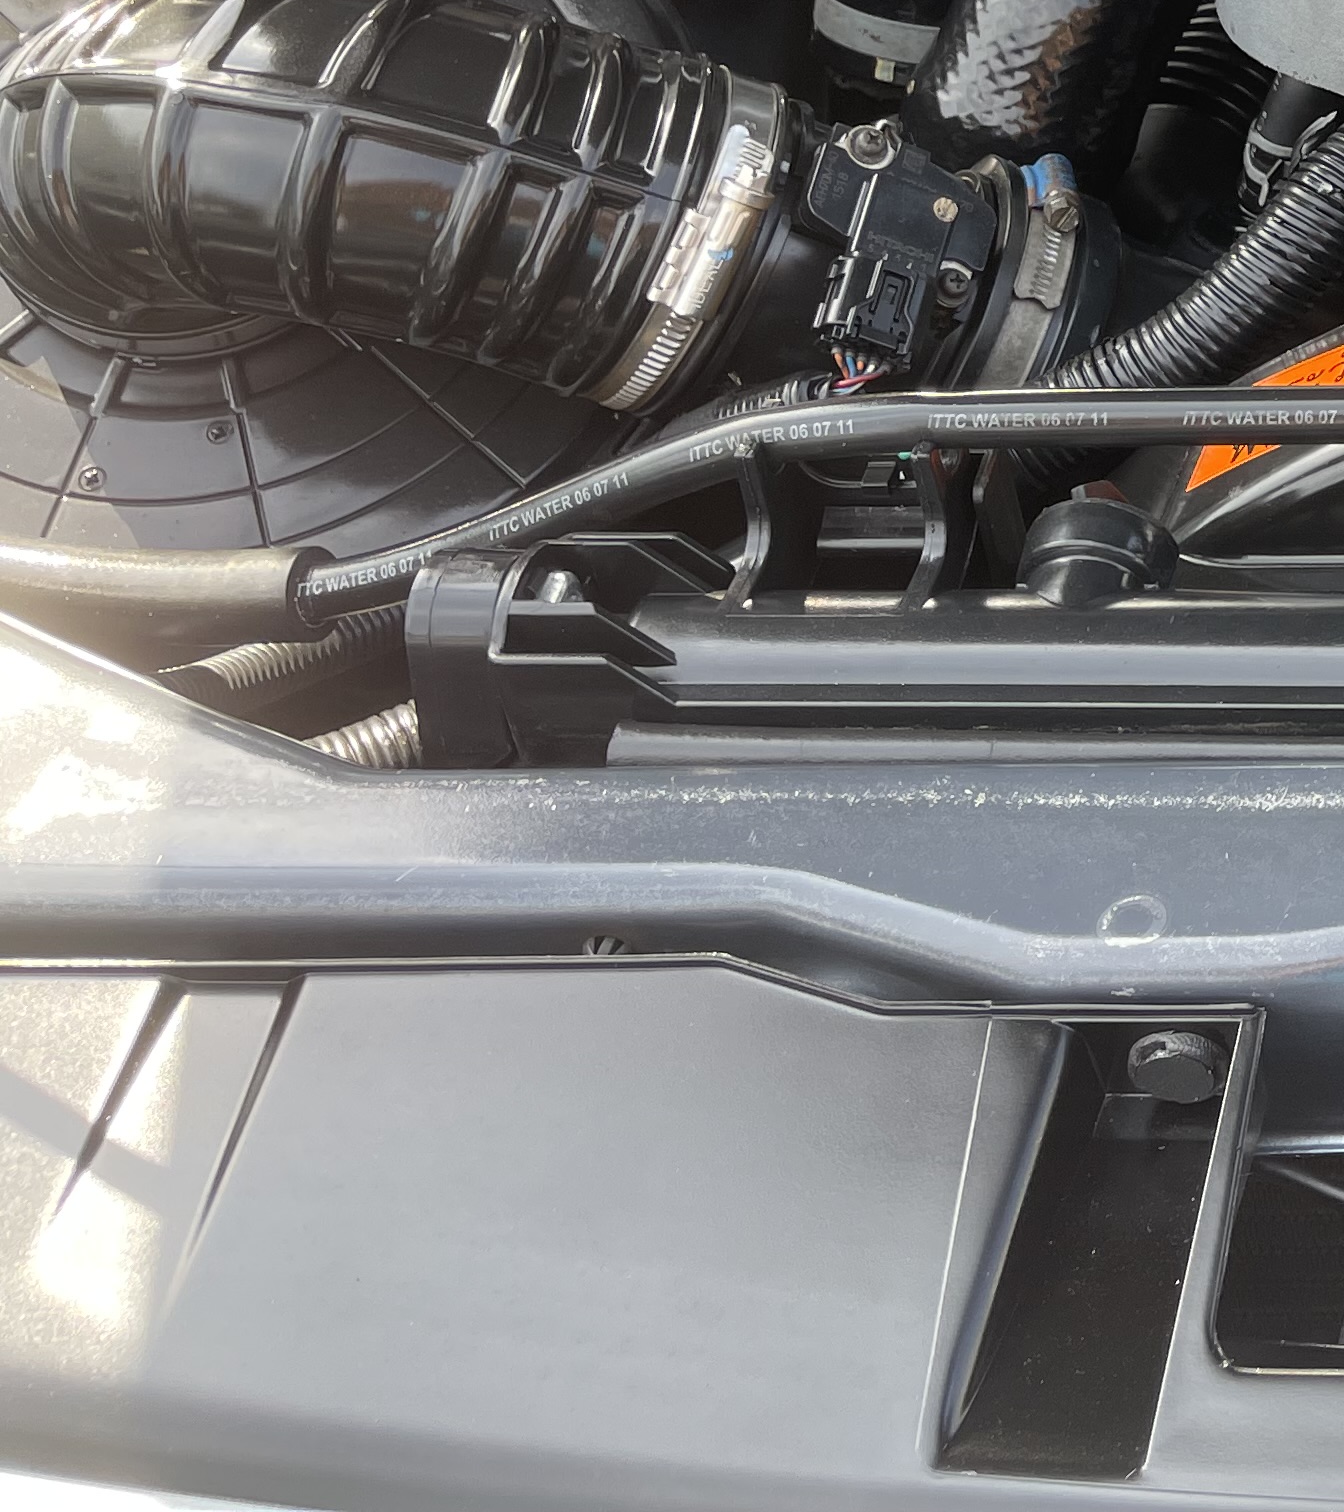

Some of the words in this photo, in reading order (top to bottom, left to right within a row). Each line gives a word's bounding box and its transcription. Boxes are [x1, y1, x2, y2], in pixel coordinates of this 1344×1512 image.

[971, 412, 1036, 429] WATER
[1040, 411, 1061, 427] 06
[1065, 411, 1085, 427] 07
[1089, 411, 1109, 426] 11
[1226, 410, 1291, 425] WATER
[1294, 409, 1314, 424] 06
[1318, 409, 1338, 424] 07
[725, 426, 786, 451] WATER
[789, 424, 809, 440] 06
[812, 421, 832, 437] 07
[836, 418, 855, 435] 11
[520, 494, 574, 527] WATER
[574, 486, 592, 505] 06
[592, 479, 609, 497] 07
[612, 471, 630, 489] 11
[325, 567, 378, 593] WATER
[379, 562, 397, 580] 06
[399, 556, 415, 573] 07
